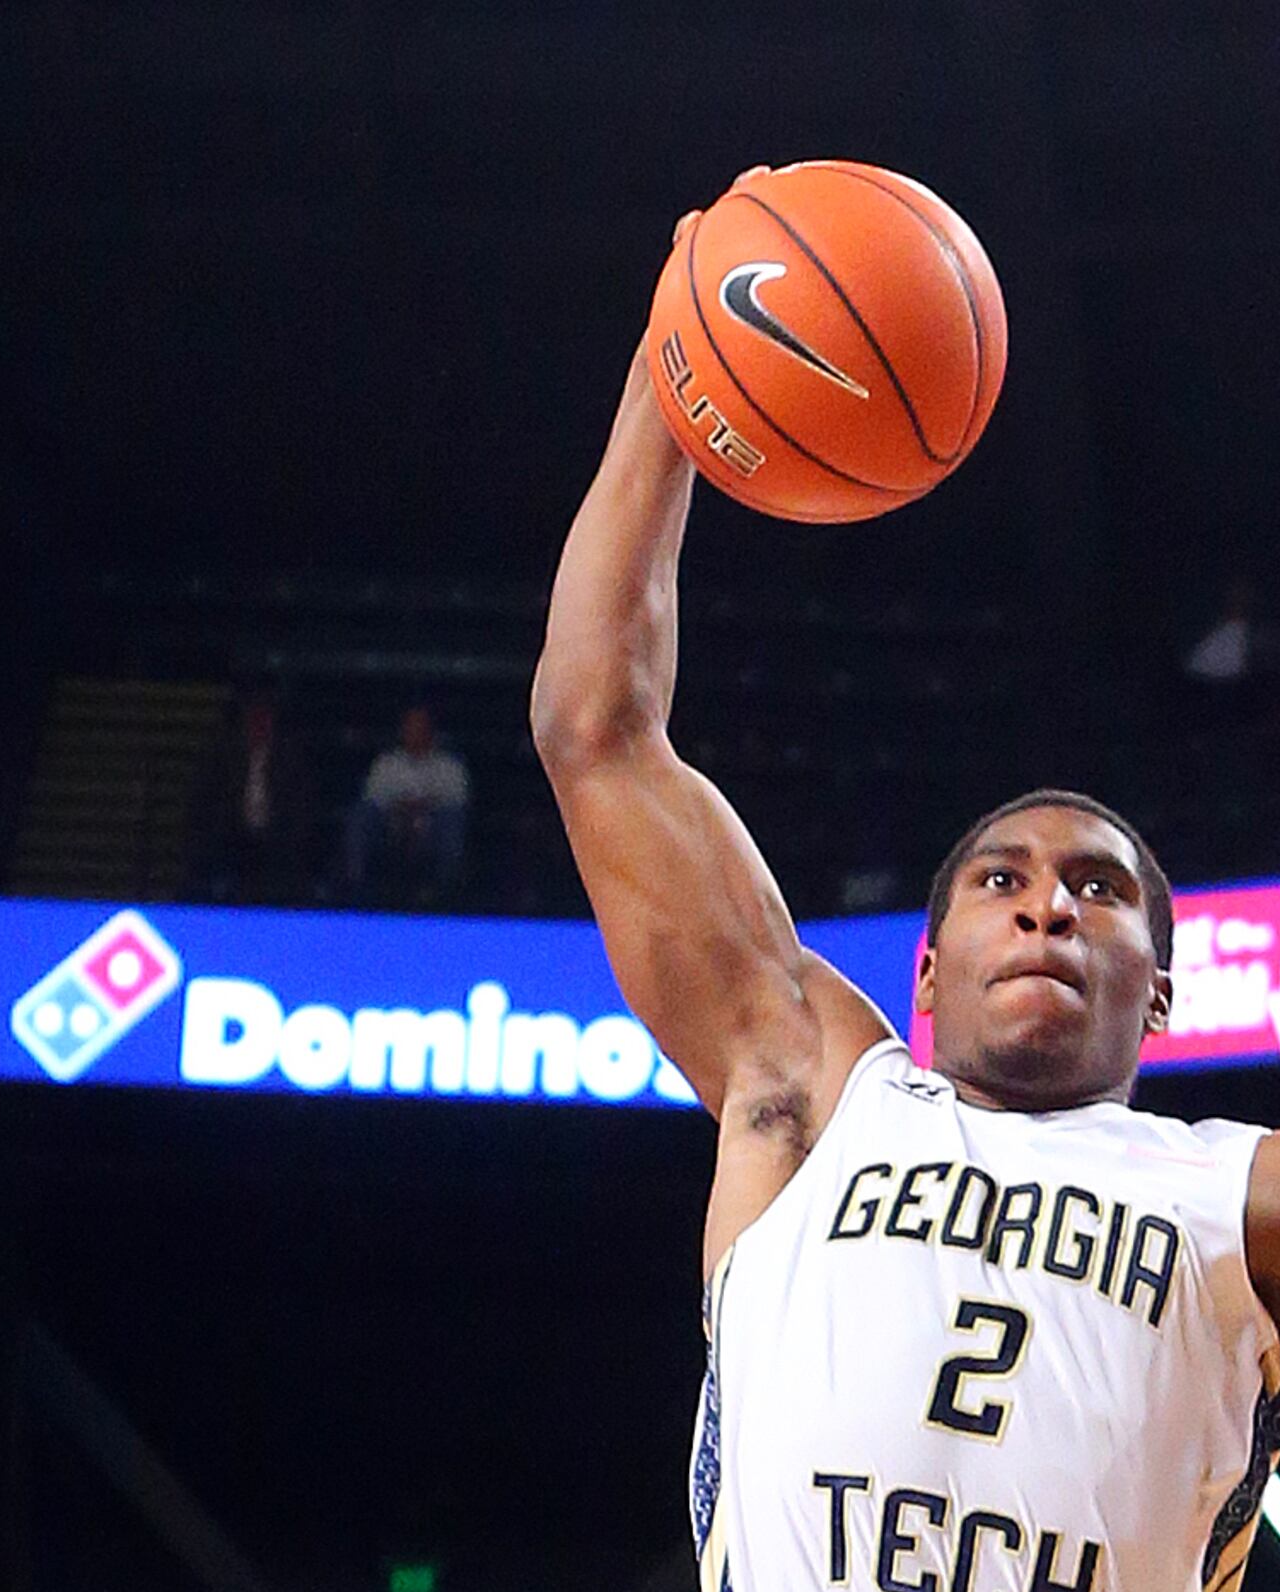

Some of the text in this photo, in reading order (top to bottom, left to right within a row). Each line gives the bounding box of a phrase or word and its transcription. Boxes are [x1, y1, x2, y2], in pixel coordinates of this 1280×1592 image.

[659, 330, 766, 478] ELITE
[826, 1160, 1184, 1330] GEORGIA
[924, 1291, 1033, 1447] 2
